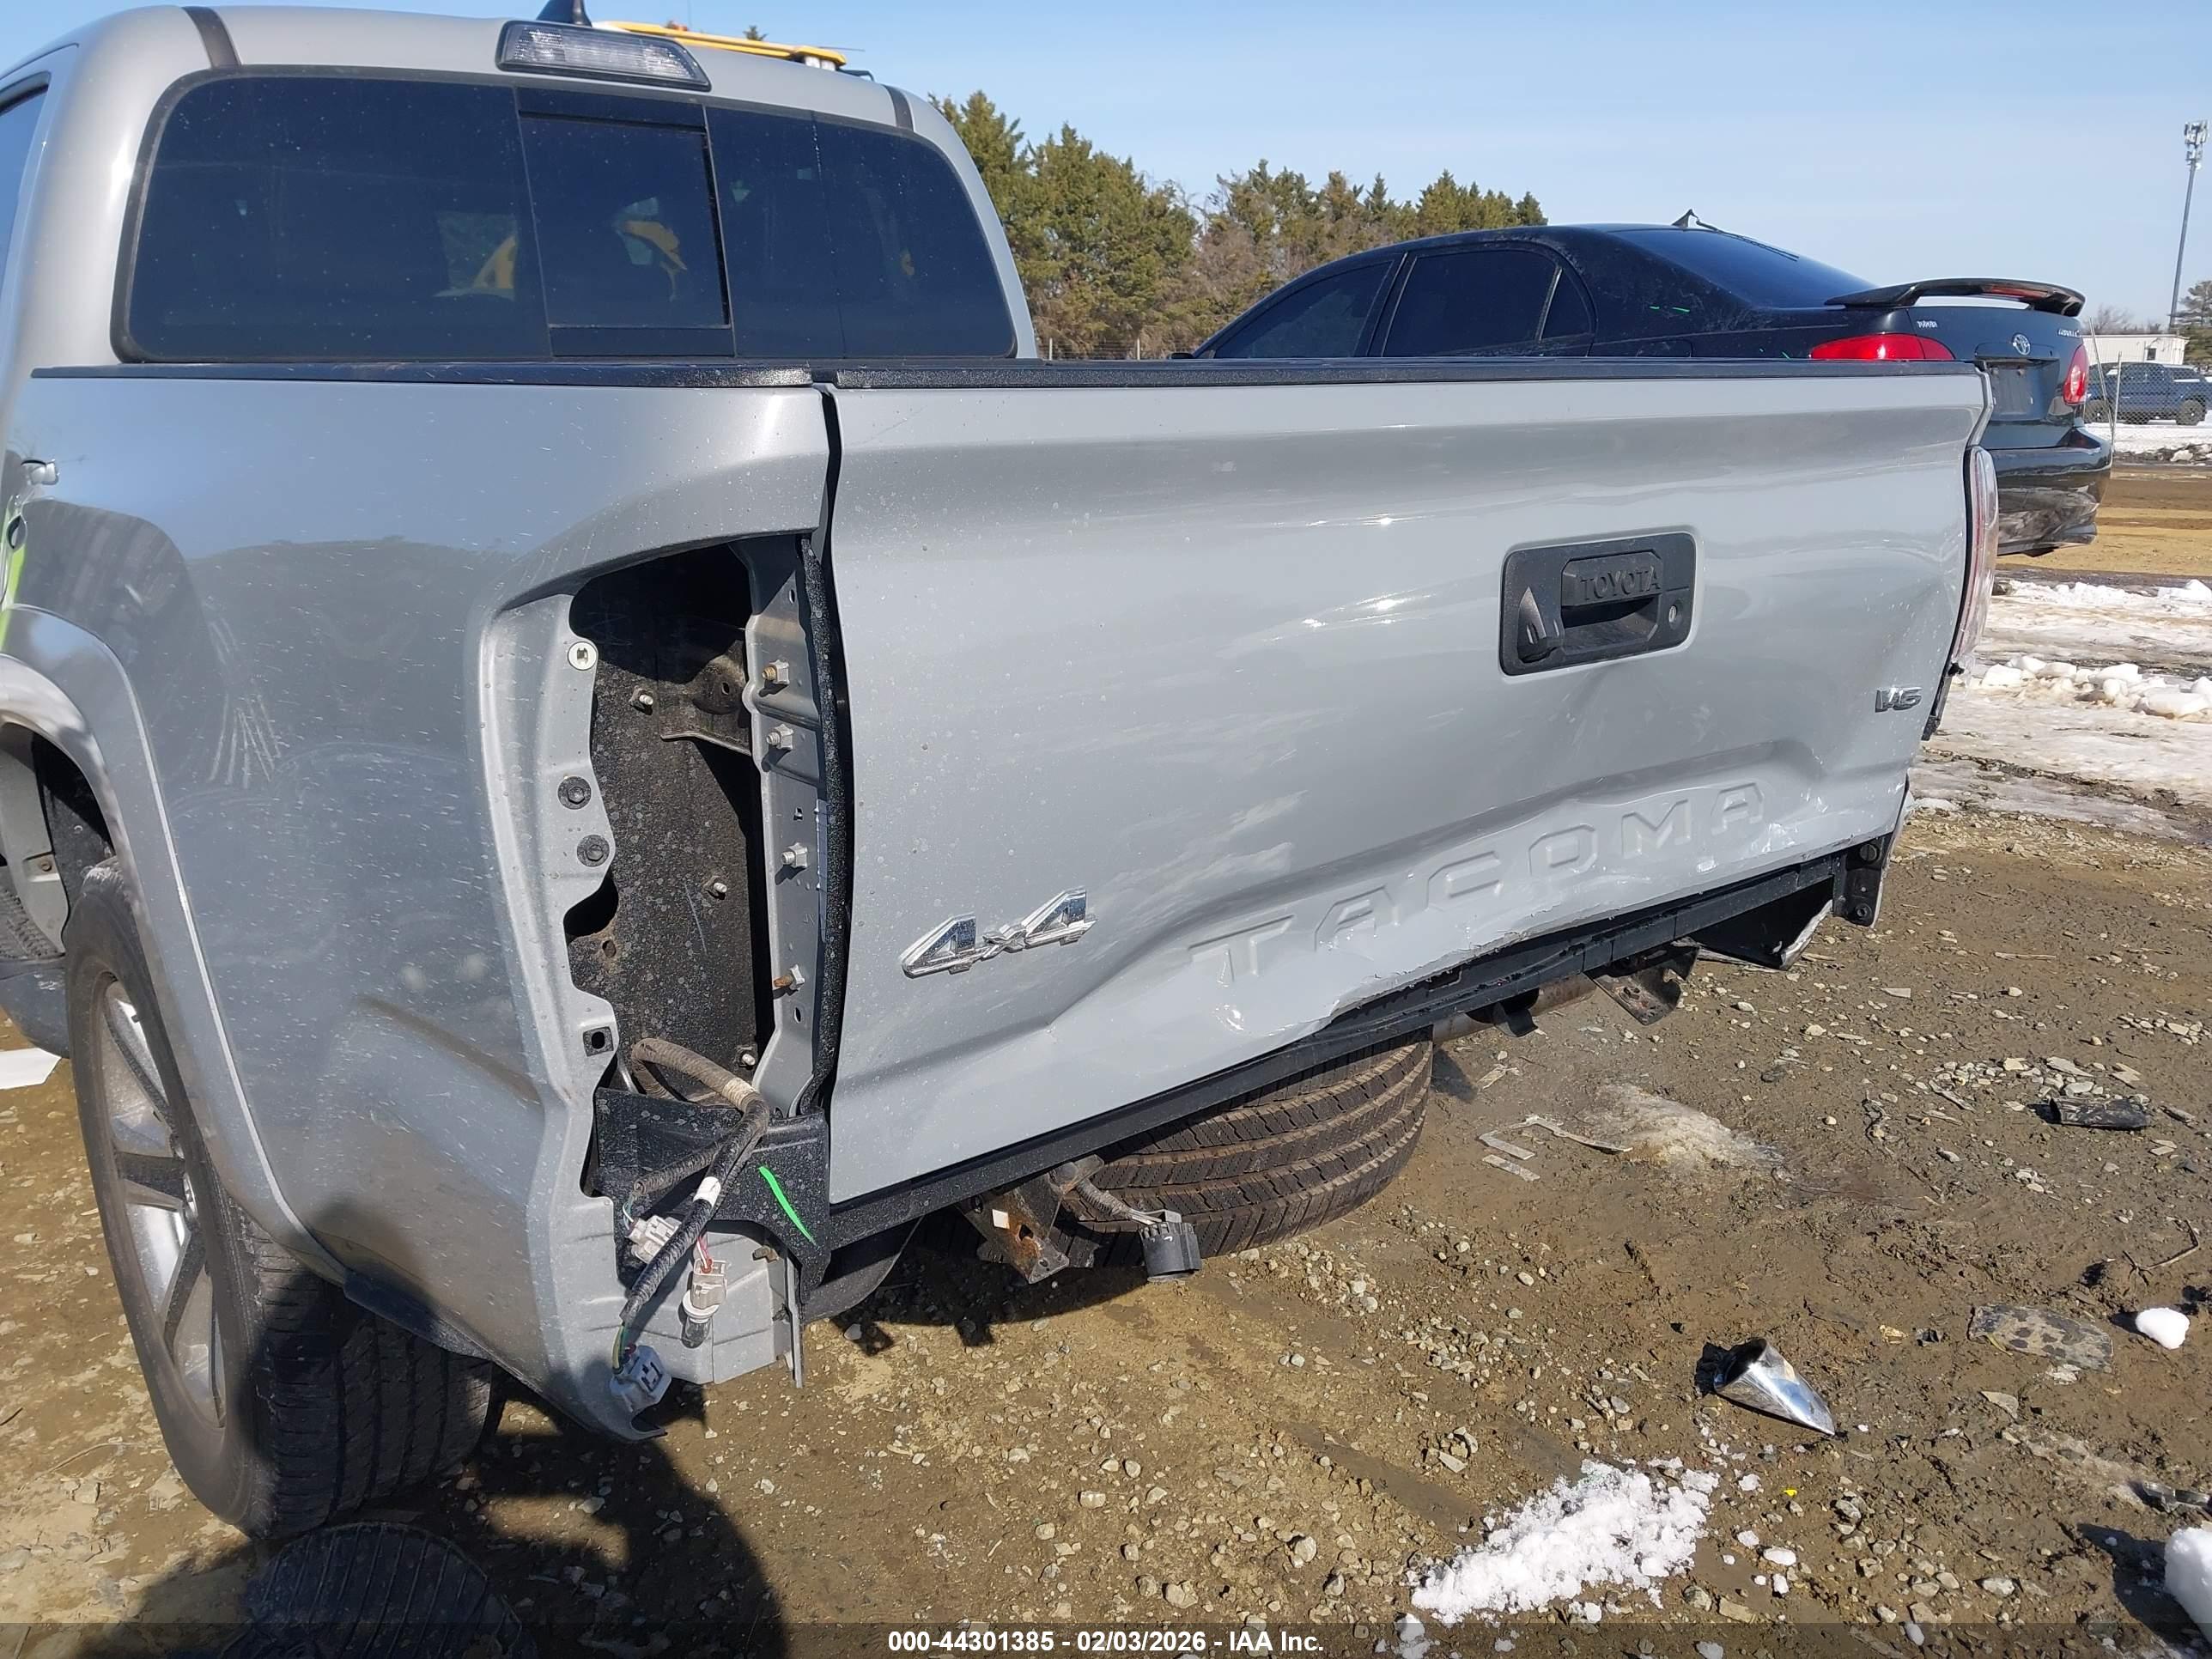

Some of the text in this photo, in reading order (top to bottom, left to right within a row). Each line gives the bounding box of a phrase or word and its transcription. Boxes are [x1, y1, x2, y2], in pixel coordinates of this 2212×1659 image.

[1580, 566, 1661, 600] TOYOTA
[1875, 685, 1923, 713] V6
[1187, 781, 1765, 983] TACOMA
